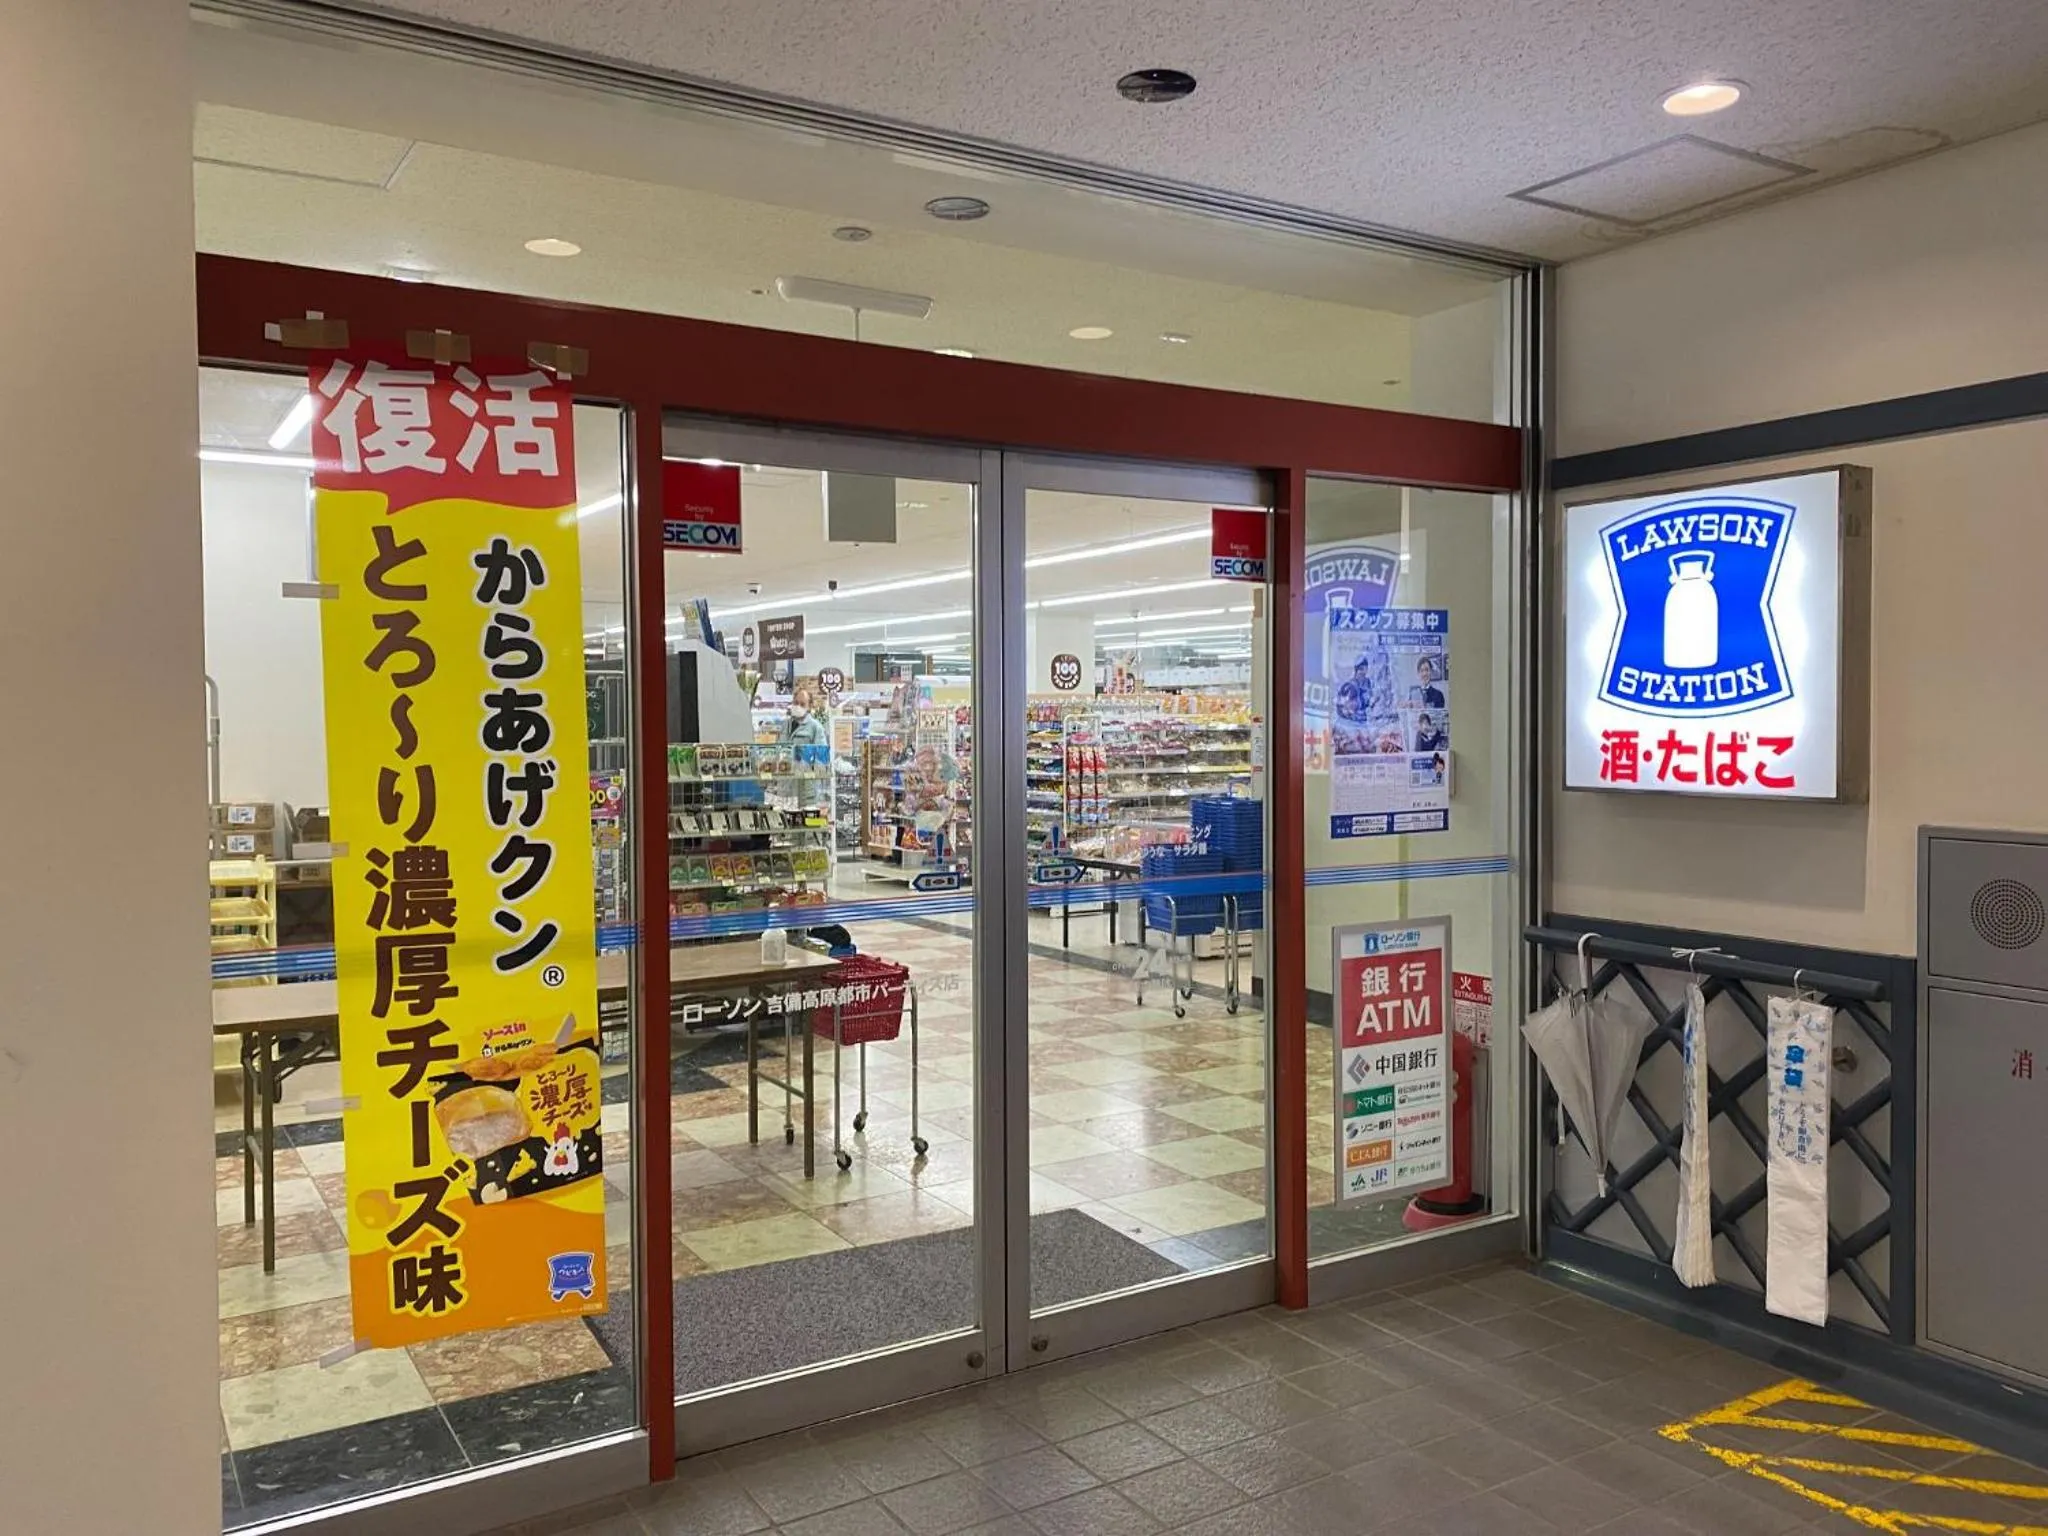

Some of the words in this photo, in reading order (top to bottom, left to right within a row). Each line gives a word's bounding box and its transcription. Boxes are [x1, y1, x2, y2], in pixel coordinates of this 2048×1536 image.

[318, 359, 560, 477] 復活
[664, 523, 737, 546] SECOM
[1617, 514, 1774, 561] LAWSON
[1214, 559, 1264, 577] SECOM
[1617, 662, 1768, 703] STATION
[1600, 729, 1796, 789] 酒・たばこ
[1361, 962, 1427, 998] 銀行
[683, 999, 762, 1024] ローソン
[1356, 995, 1431, 1037] ATM
[1375, 1048, 1438, 1075] 中国銀行
[530, 1072, 593, 1111] 濃厚
[1356, 1092, 1393, 1109] トマト銀行
[541, 1099, 593, 1127] チーズ
[1360, 1119, 1392, 1133] ソニー銀行
